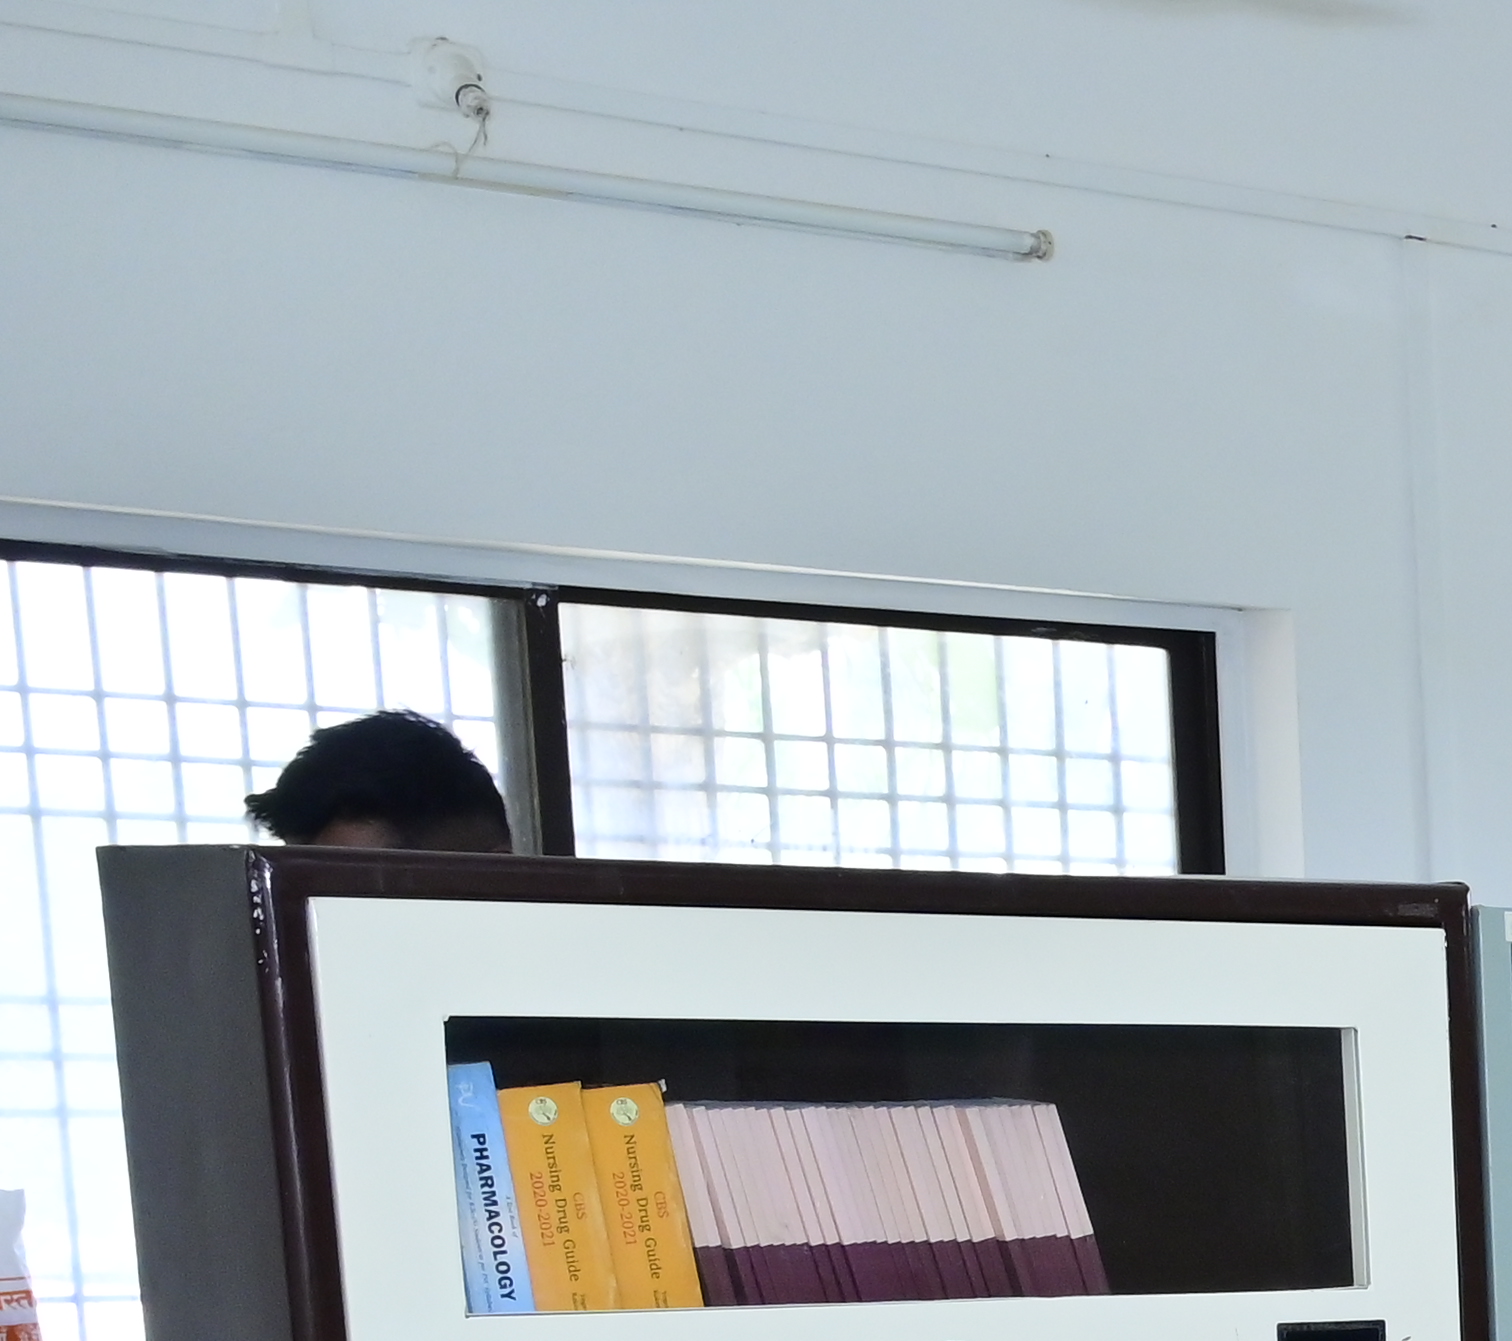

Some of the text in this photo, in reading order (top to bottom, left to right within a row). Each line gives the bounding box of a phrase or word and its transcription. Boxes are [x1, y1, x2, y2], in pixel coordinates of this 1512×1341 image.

[471, 1133, 516, 1301] PHARMACOLOGY
[529, 1172, 554, 1248] 2020-2021
[542, 1134, 579, 1281] Nursing Drug Guide
[573, 1192, 587, 1220] CBS
[613, 1172, 636, 1246] 2020-2021
[624, 1134, 660, 1279] Nursing Drug Guide
[654, 1191, 668, 1218] CBS
